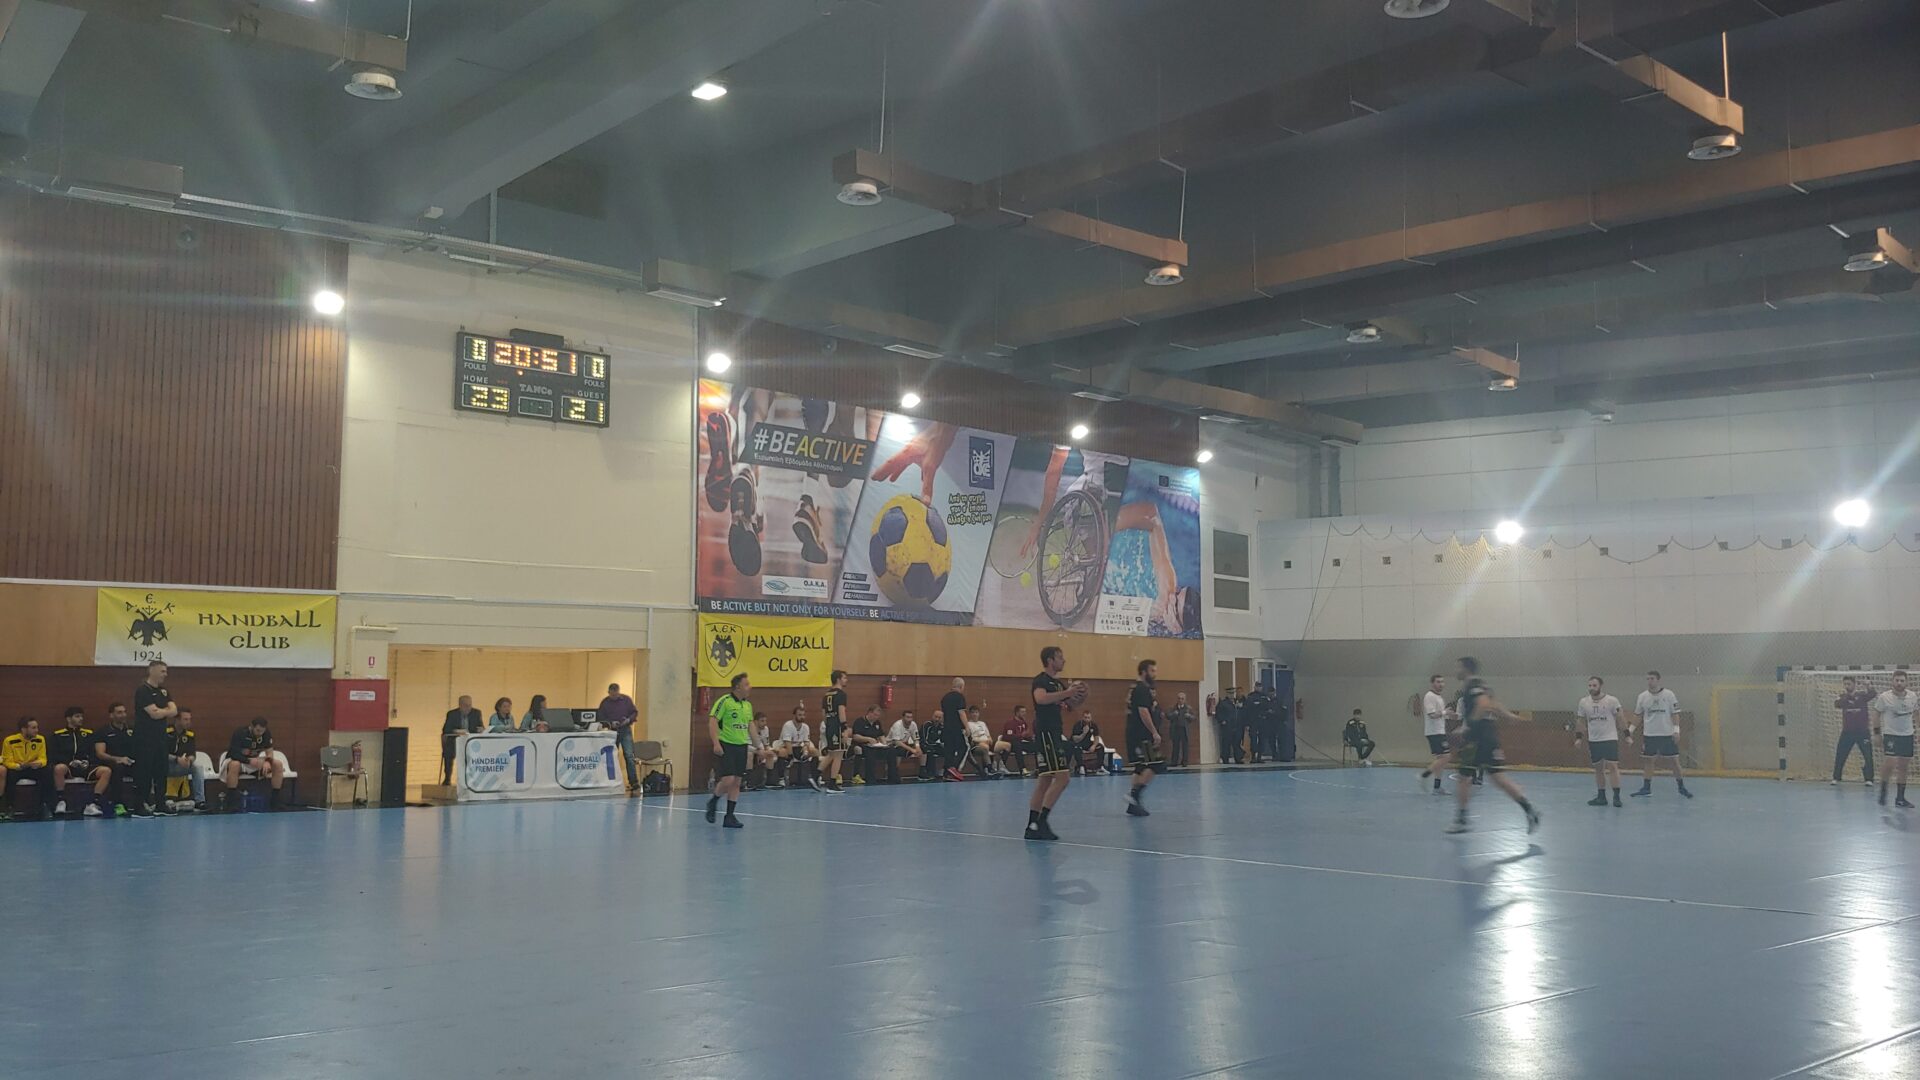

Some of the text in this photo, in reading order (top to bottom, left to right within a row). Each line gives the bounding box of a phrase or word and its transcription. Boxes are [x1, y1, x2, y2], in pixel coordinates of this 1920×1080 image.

[472, 339, 486, 361] 0
[494, 342, 576, 375] 20:51
[464, 363, 486, 371] FOULS
[592, 357, 604, 379] 0
[464, 375, 488, 384] HOME
[584, 379, 605, 388] FOULS
[470, 385, 508, 410] 23
[577, 390, 605, 399] GUEST
[569, 398, 604, 422] 21
[754, 428, 867, 466] #BEACTIVE
[711, 600, 721, 610] BE
[723, 601, 753, 612] ACTIVE
[754, 602, 770, 613] BUT
[773, 603, 790, 613] NOT
[792, 604, 812, 614] ONLY
[814, 605, 829, 615] FOR
[869, 609, 879, 618] BE
[198, 610, 322, 628] HANDBALL
[746, 634, 830, 650] HANDBALL
[133, 650, 163, 662] 1924
[768, 657, 809, 672] CLUB
[827, 695, 833, 712] 9
[471, 757, 509, 765] HANDBALL
[509, 745, 525, 784] 1
[563, 755, 600, 764] HANDBALL
[567, 763, 597, 771] PREMIER
[601, 745, 616, 781] 1
